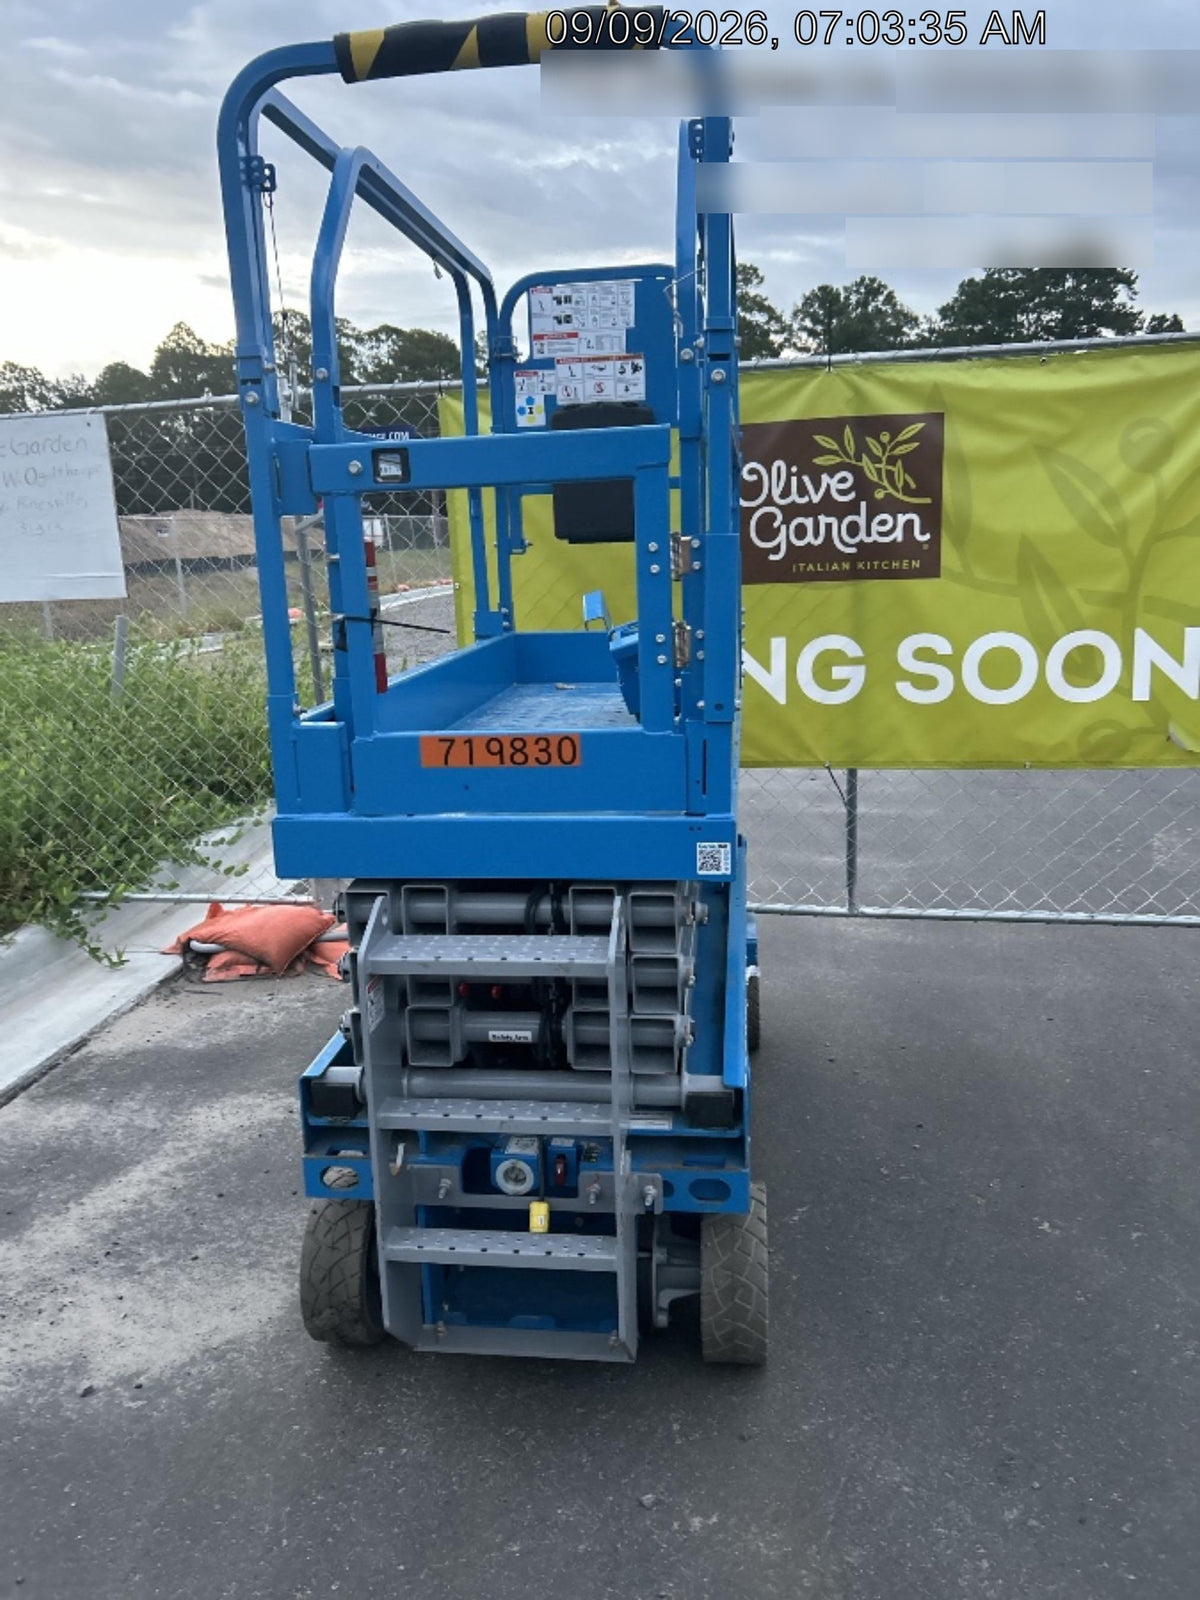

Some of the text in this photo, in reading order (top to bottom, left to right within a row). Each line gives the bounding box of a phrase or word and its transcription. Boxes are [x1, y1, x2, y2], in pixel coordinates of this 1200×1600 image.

[739, 459, 856, 508] Olive
[749, 501, 931, 561] Garden
[792, 559, 921, 573] ITALIAN KITCHEN
[742, 627, 1200, 705] NG SOON
[438, 735, 577, 766] 719830
